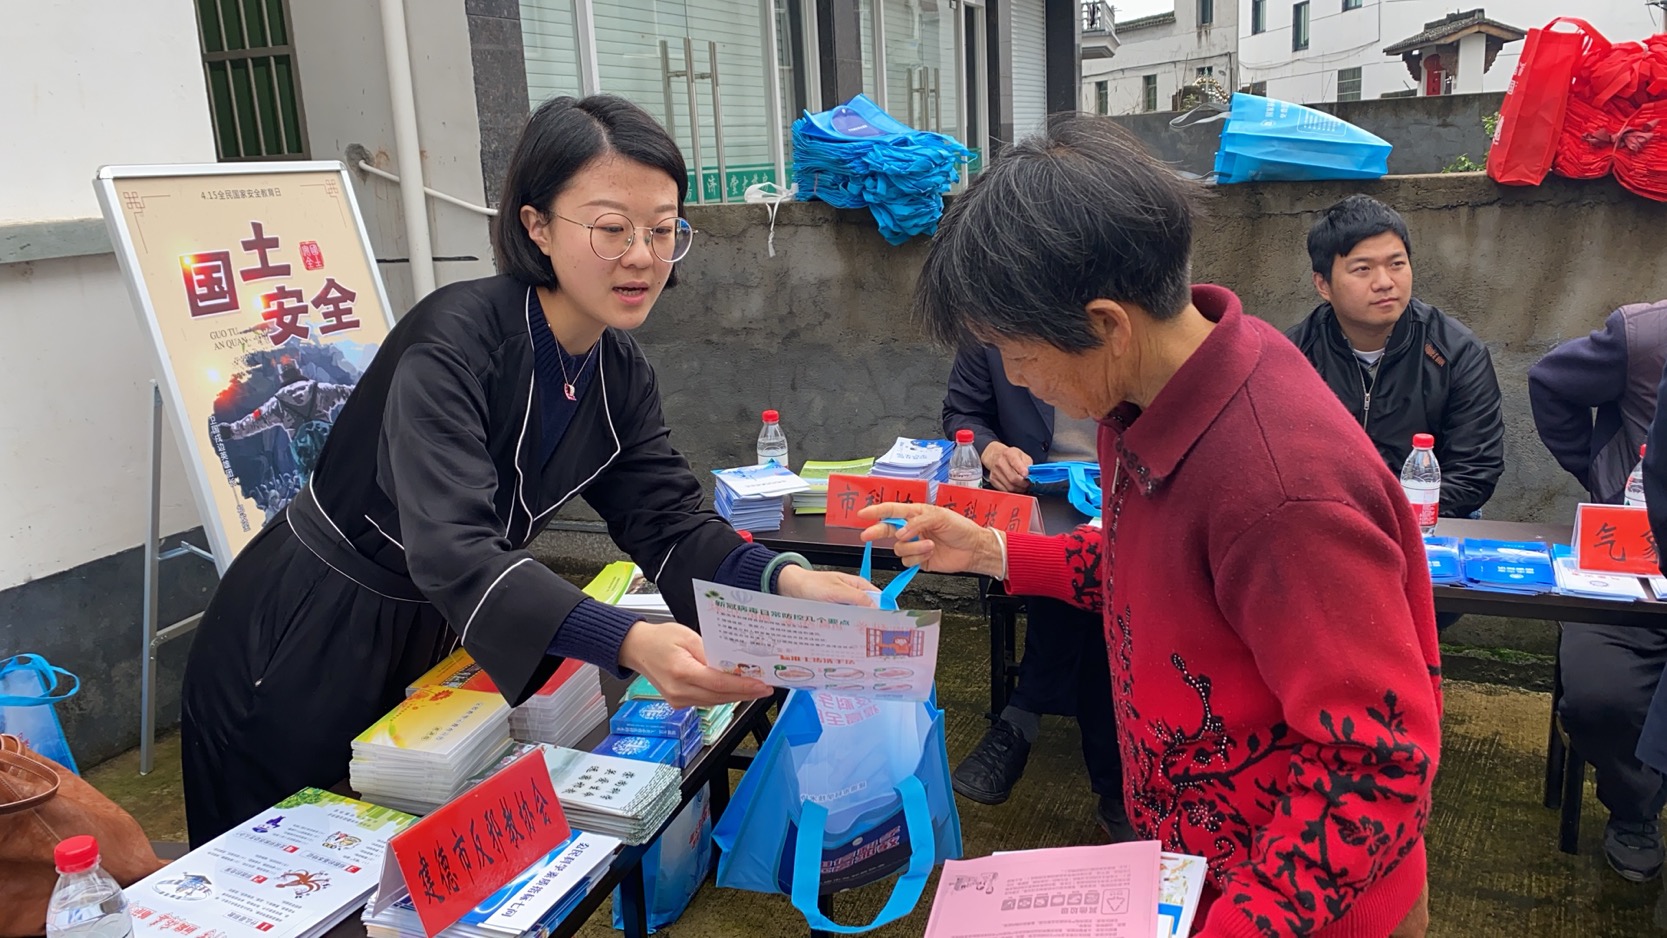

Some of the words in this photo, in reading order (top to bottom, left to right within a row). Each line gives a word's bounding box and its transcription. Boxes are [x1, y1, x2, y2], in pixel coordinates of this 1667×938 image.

[201, 187, 282, 200] 4.15全民国家安全教育日
[210, 329, 227, 340] GUO
[227, 327, 238, 336] TU
[214, 340, 225, 351] AN
[226, 336, 248, 349] QUAN
[715, 599, 850, 626] 新冠病毒日常防控几个要点
[417, 776, 552, 905] 建德市反邪教协会
[500, 842, 591, 920] 公民科学素质指标七问
